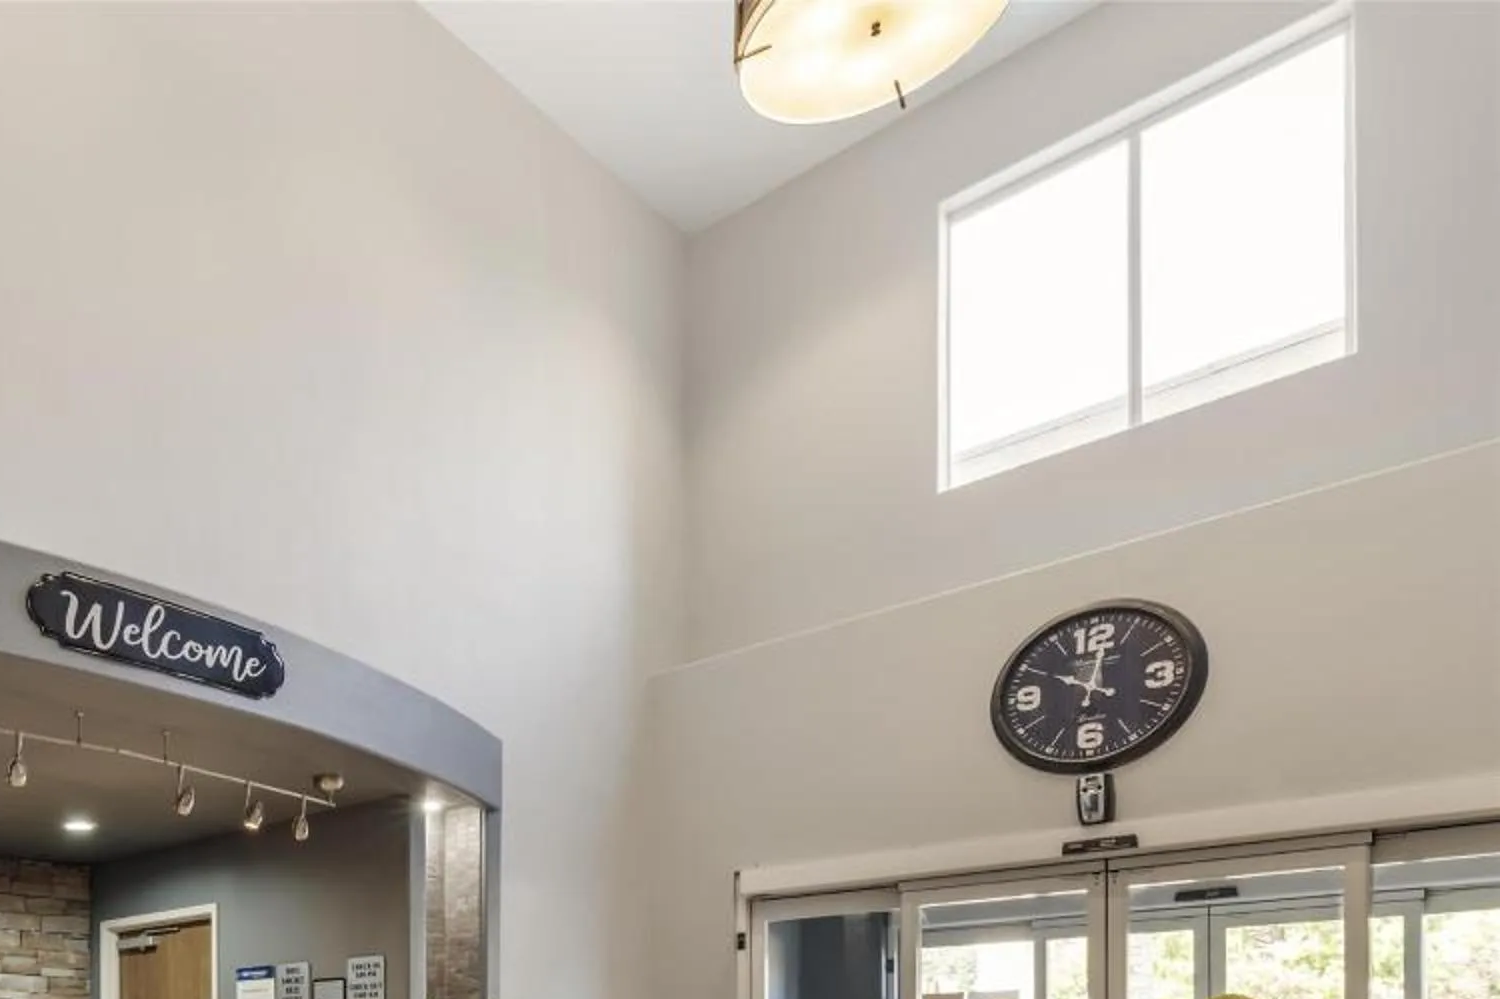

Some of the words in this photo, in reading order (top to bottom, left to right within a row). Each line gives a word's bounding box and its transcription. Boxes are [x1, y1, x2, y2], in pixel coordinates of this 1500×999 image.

[60, 589, 267, 683] Welcome
[1073, 622, 1116, 655] 12
[1144, 659, 1176, 690] 3
[1015, 685, 1042, 712] 9
[1076, 721, 1105, 750] 6
